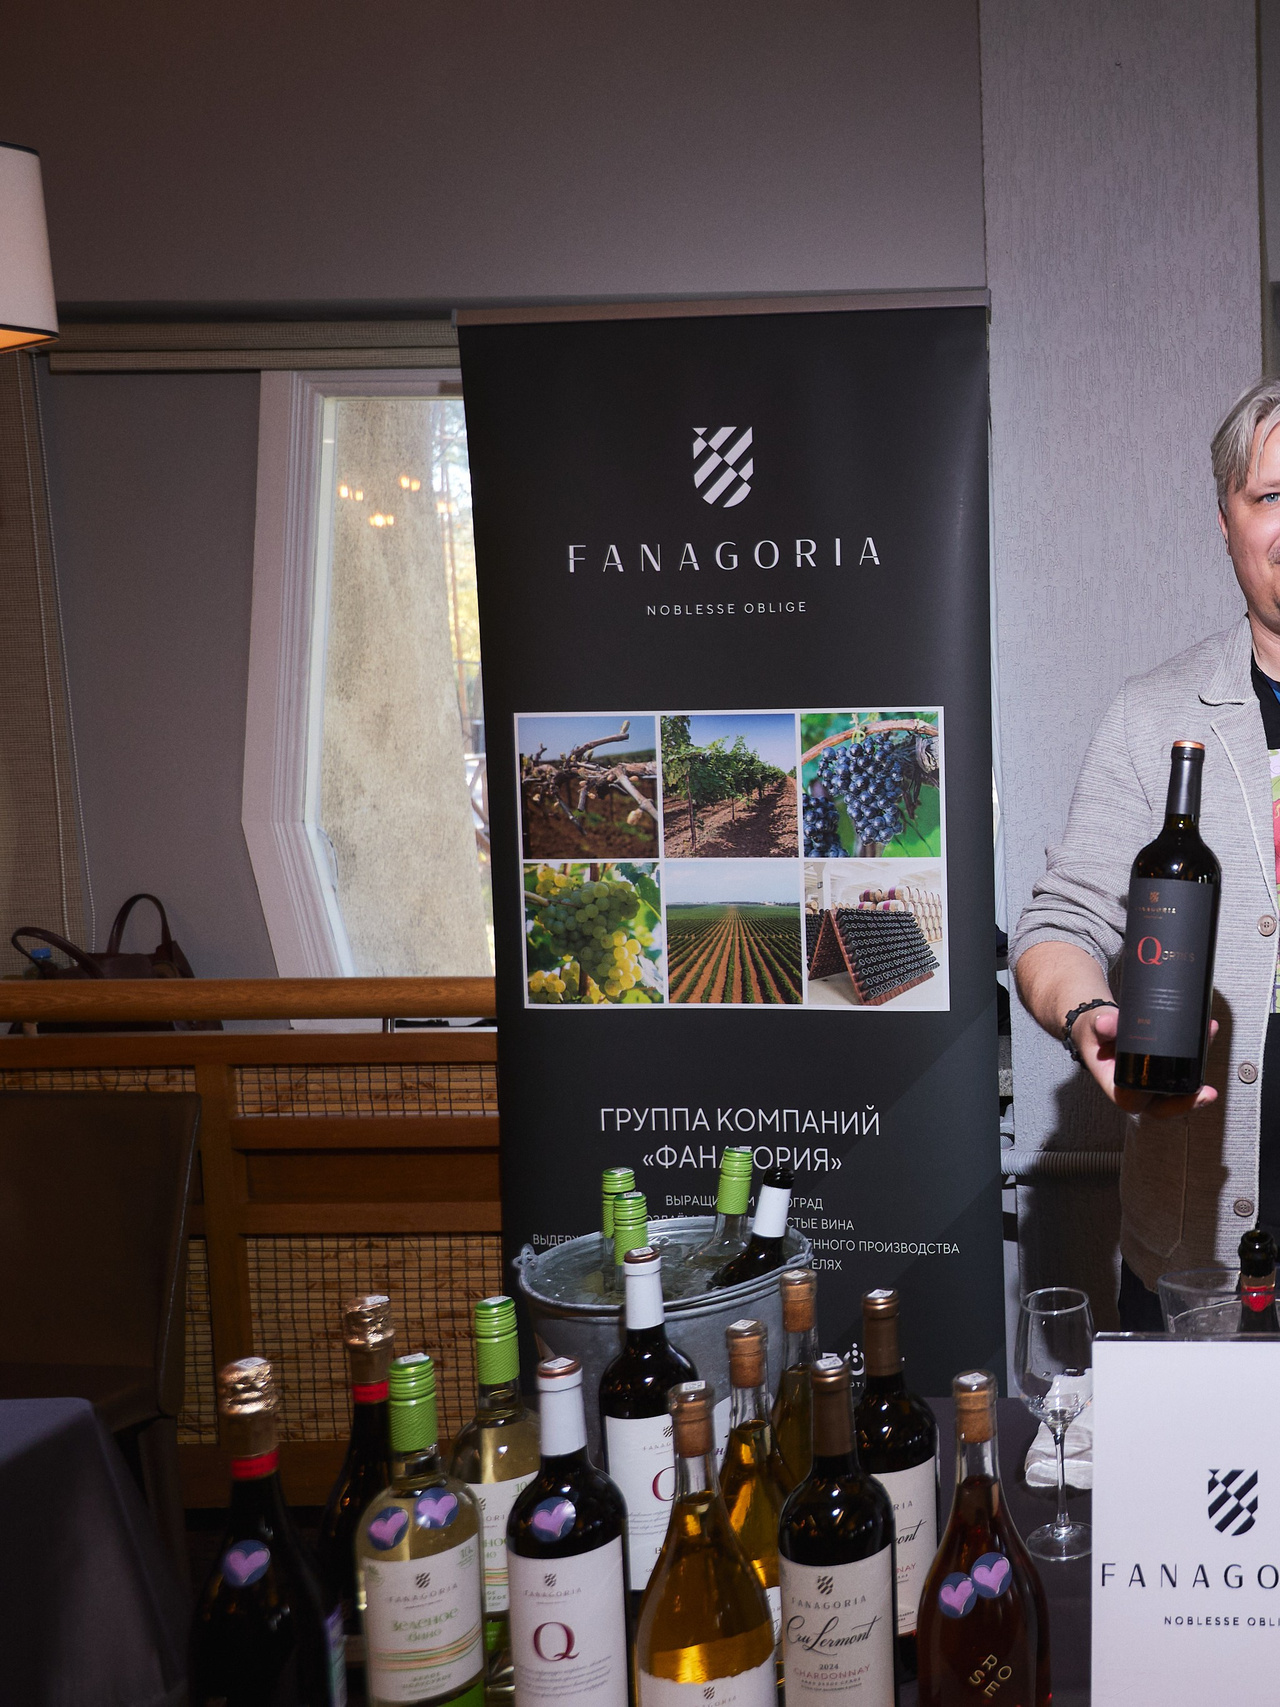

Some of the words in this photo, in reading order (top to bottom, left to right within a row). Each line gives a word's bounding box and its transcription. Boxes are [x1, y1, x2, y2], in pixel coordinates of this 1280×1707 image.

[568, 536, 882, 573] FANAGORIA
[646, 602, 736, 617] NOBLESSE
[743, 600, 807, 615] OBLIGE
[599, 1107, 711, 1132] ГРУППА
[716, 1104, 881, 1136] КОМПАНИЙ
[642, 1144, 843, 1172] «ФАНОРИЯ»
[665, 1194, 755, 1209] ВЫРАЩИМ
[822, 1217, 855, 1231] ВИНА
[858, 1240, 961, 1256] ПРОИЗВОДСТВА
[791, 1594, 867, 1610] FANAGORIA
[1163, 1615, 1240, 1627] NOBLESSE
[534, 1621, 580, 1662] Q
[786, 1615, 812, 1644] Cru
[802, 1615, 883, 1656] Lermont
[793, 1663, 871, 1680] CHARDONNAY
[819, 1663, 840, 1671] 2024
